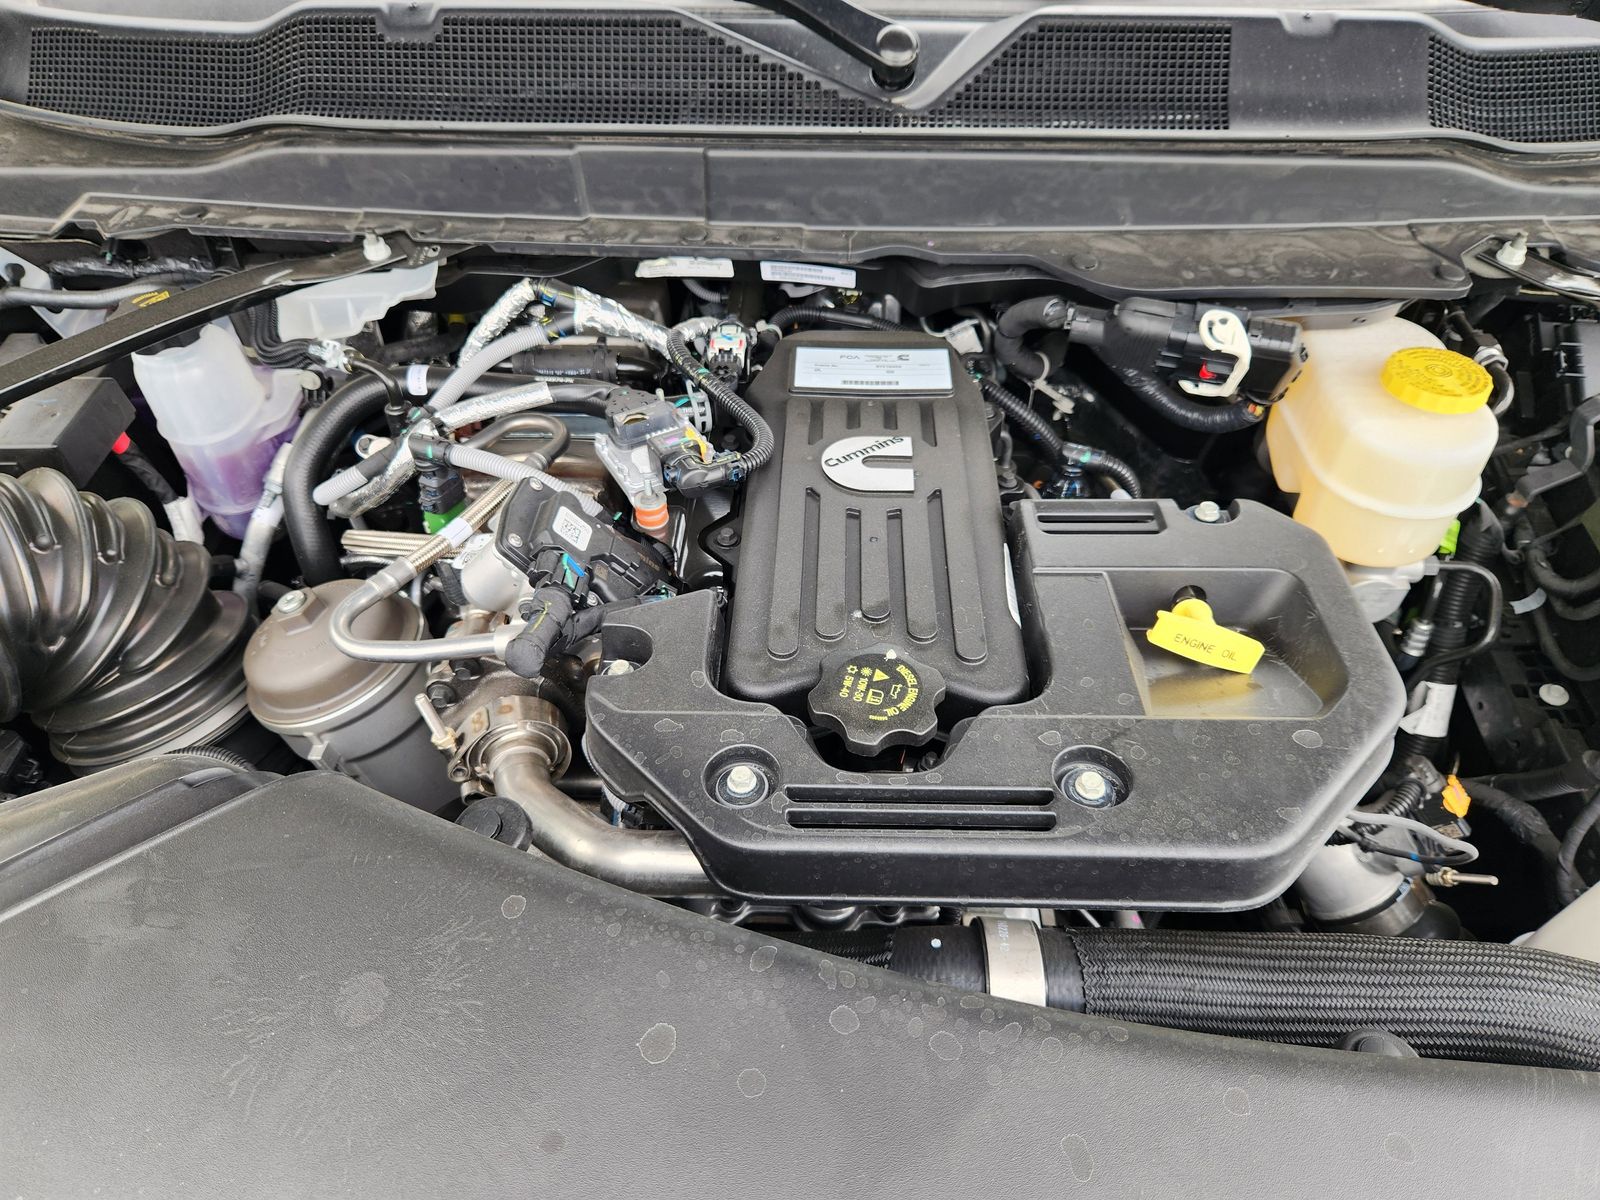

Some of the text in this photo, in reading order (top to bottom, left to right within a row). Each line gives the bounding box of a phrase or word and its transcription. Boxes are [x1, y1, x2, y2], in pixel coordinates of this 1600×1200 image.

[824, 435, 904, 468] Cummins
[1174, 633, 1237, 661] ENGINE OIL
[839, 675, 854, 698] 5W-40
[853, 677, 868, 702] 10W-30
[883, 664, 919, 716] DIESEL ENGINE OIL
